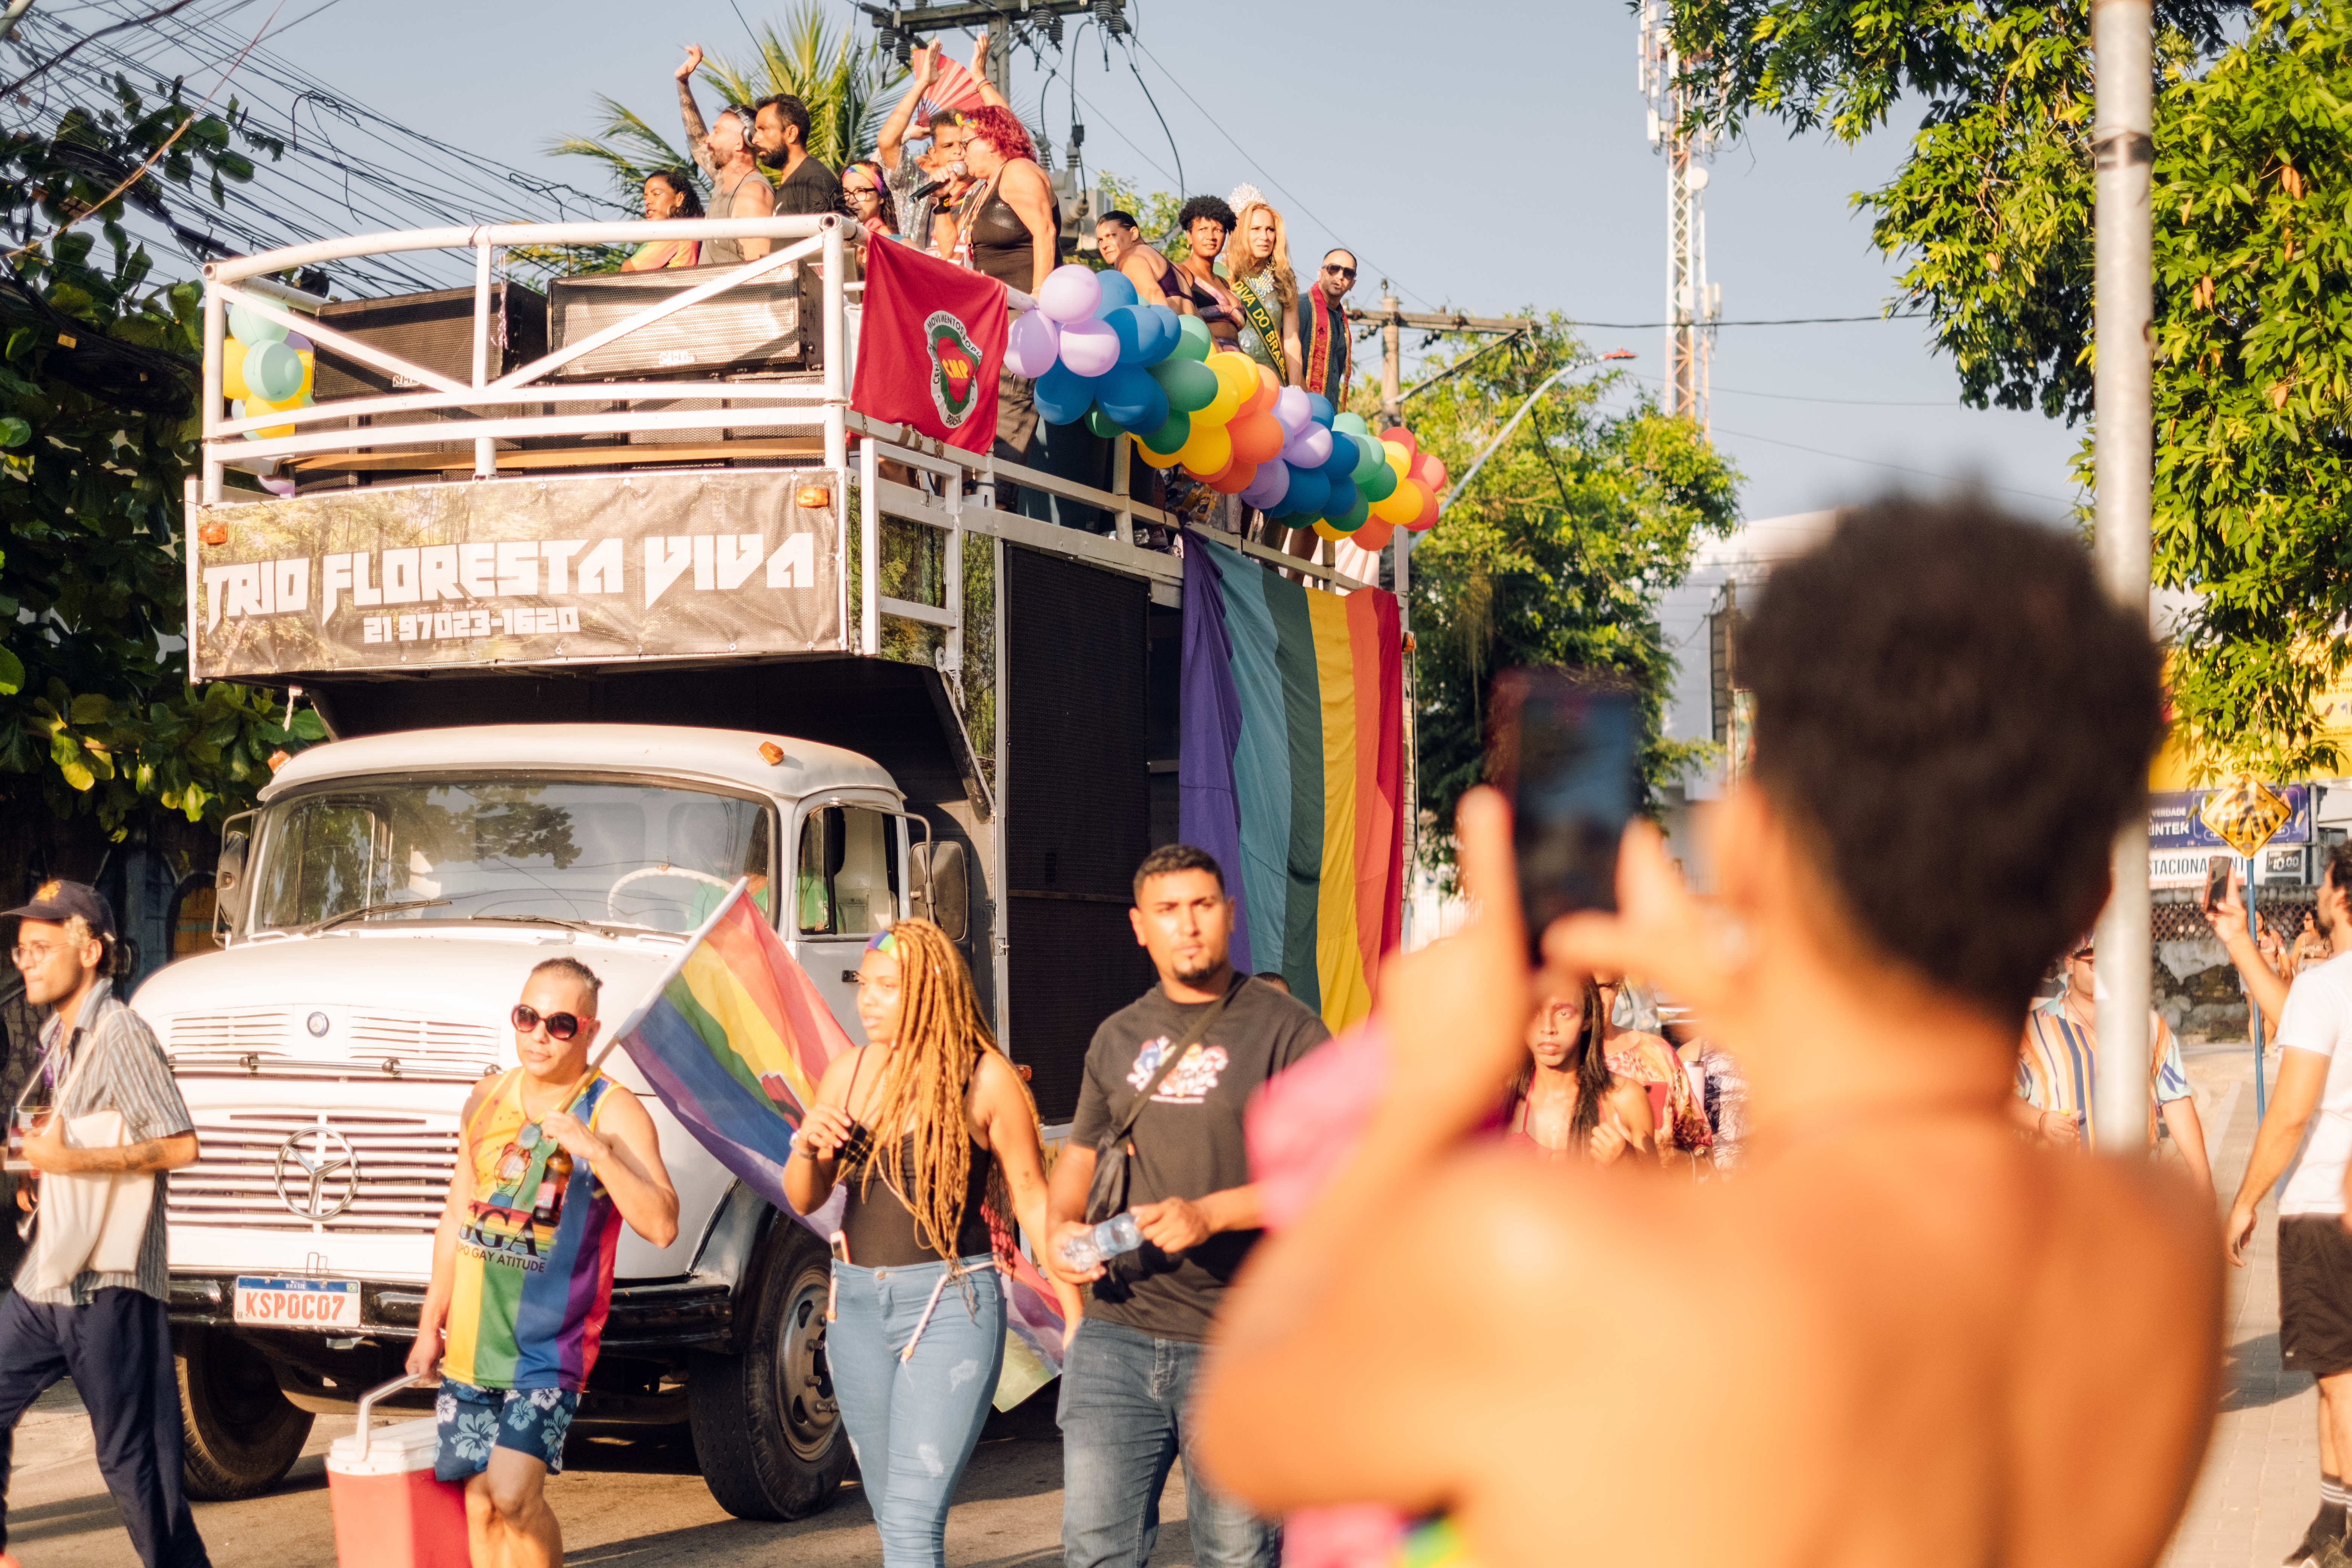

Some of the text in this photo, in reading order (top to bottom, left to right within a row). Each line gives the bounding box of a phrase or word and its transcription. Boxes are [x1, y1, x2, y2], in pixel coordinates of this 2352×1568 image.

[1231, 280, 1286, 380] DIVA DO BRASIL
[942, 358, 968, 378] CMP
[946, 413, 962, 426] BRASIL
[203, 533, 814, 636] TRIO FLORESTA VIVA
[363, 607, 580, 644] 21 97023-1620
[2151, 807, 2186, 817] VERDADE
[472, 1247, 494, 1262] GAY
[496, 1254, 546, 1273] ATITUDE
[237, 1311, 243, 1319] BR
